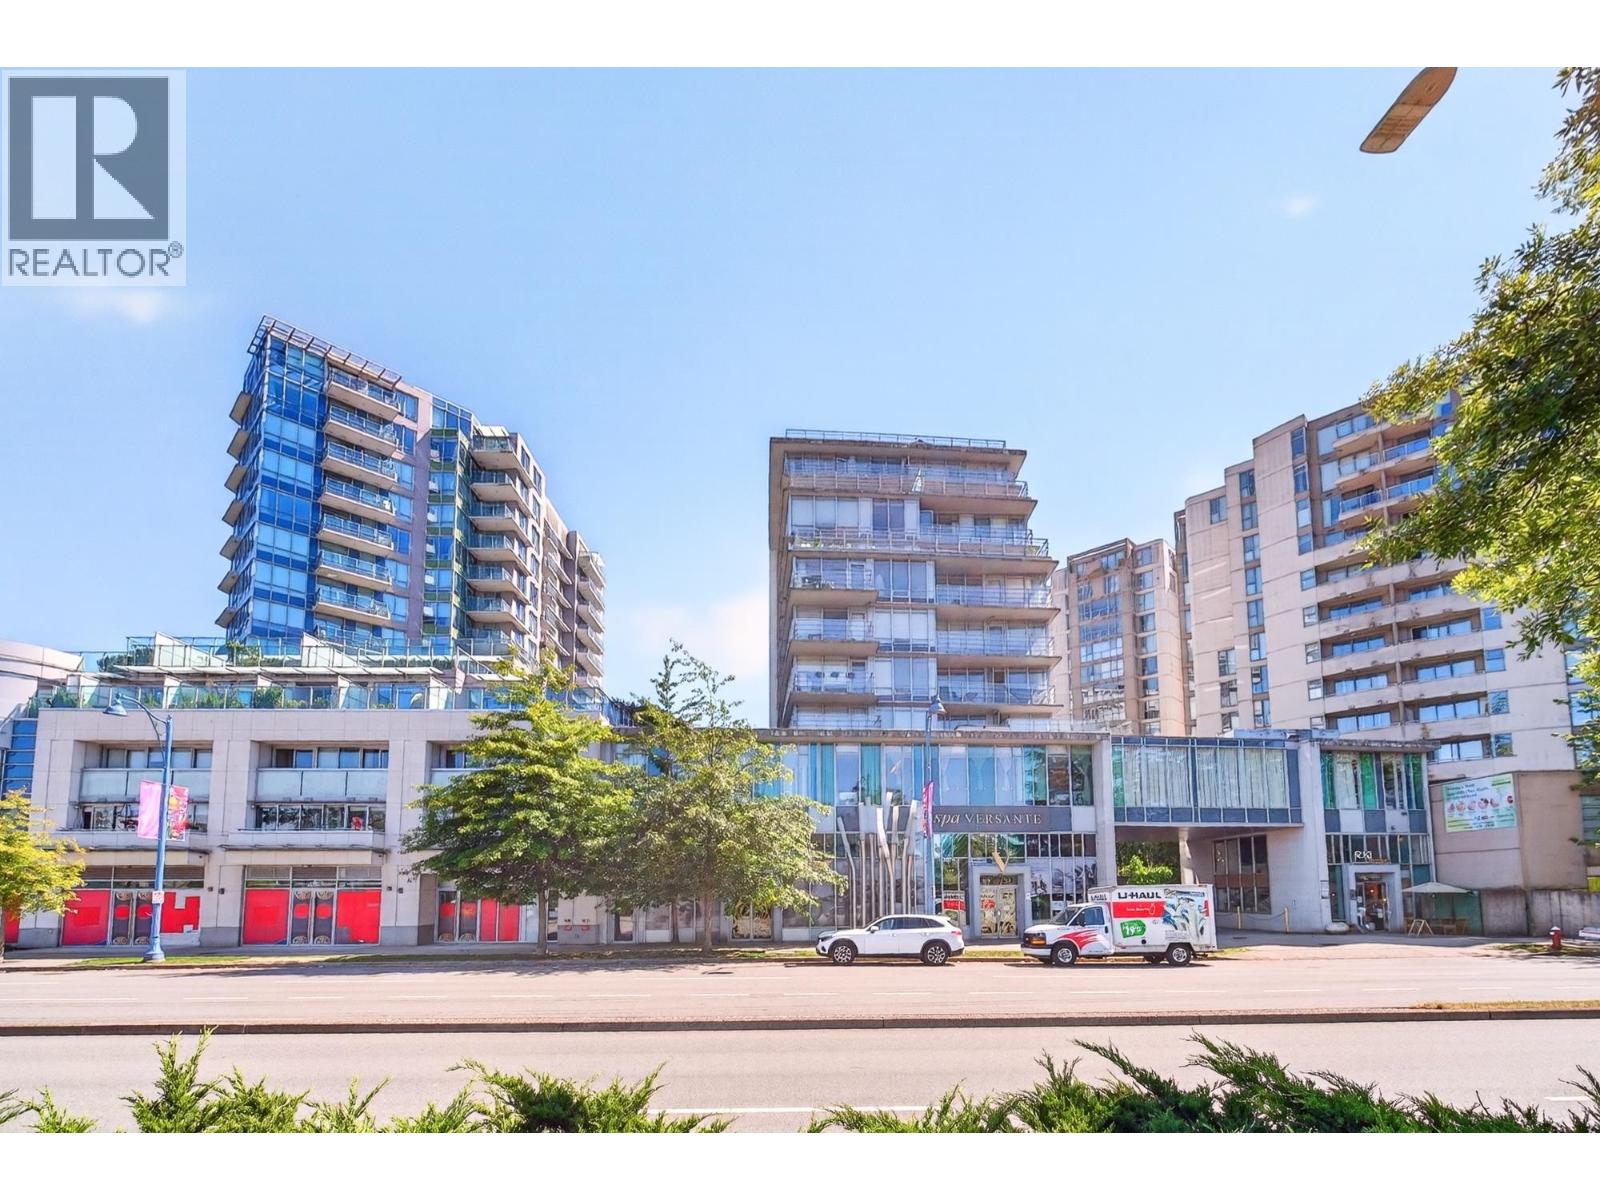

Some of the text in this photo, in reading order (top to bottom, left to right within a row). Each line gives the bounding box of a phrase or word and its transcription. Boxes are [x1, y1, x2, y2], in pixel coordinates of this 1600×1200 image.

[933, 813, 1042, 827] spa VERSANTE
[1117, 891, 1162, 899] U-HAUL
